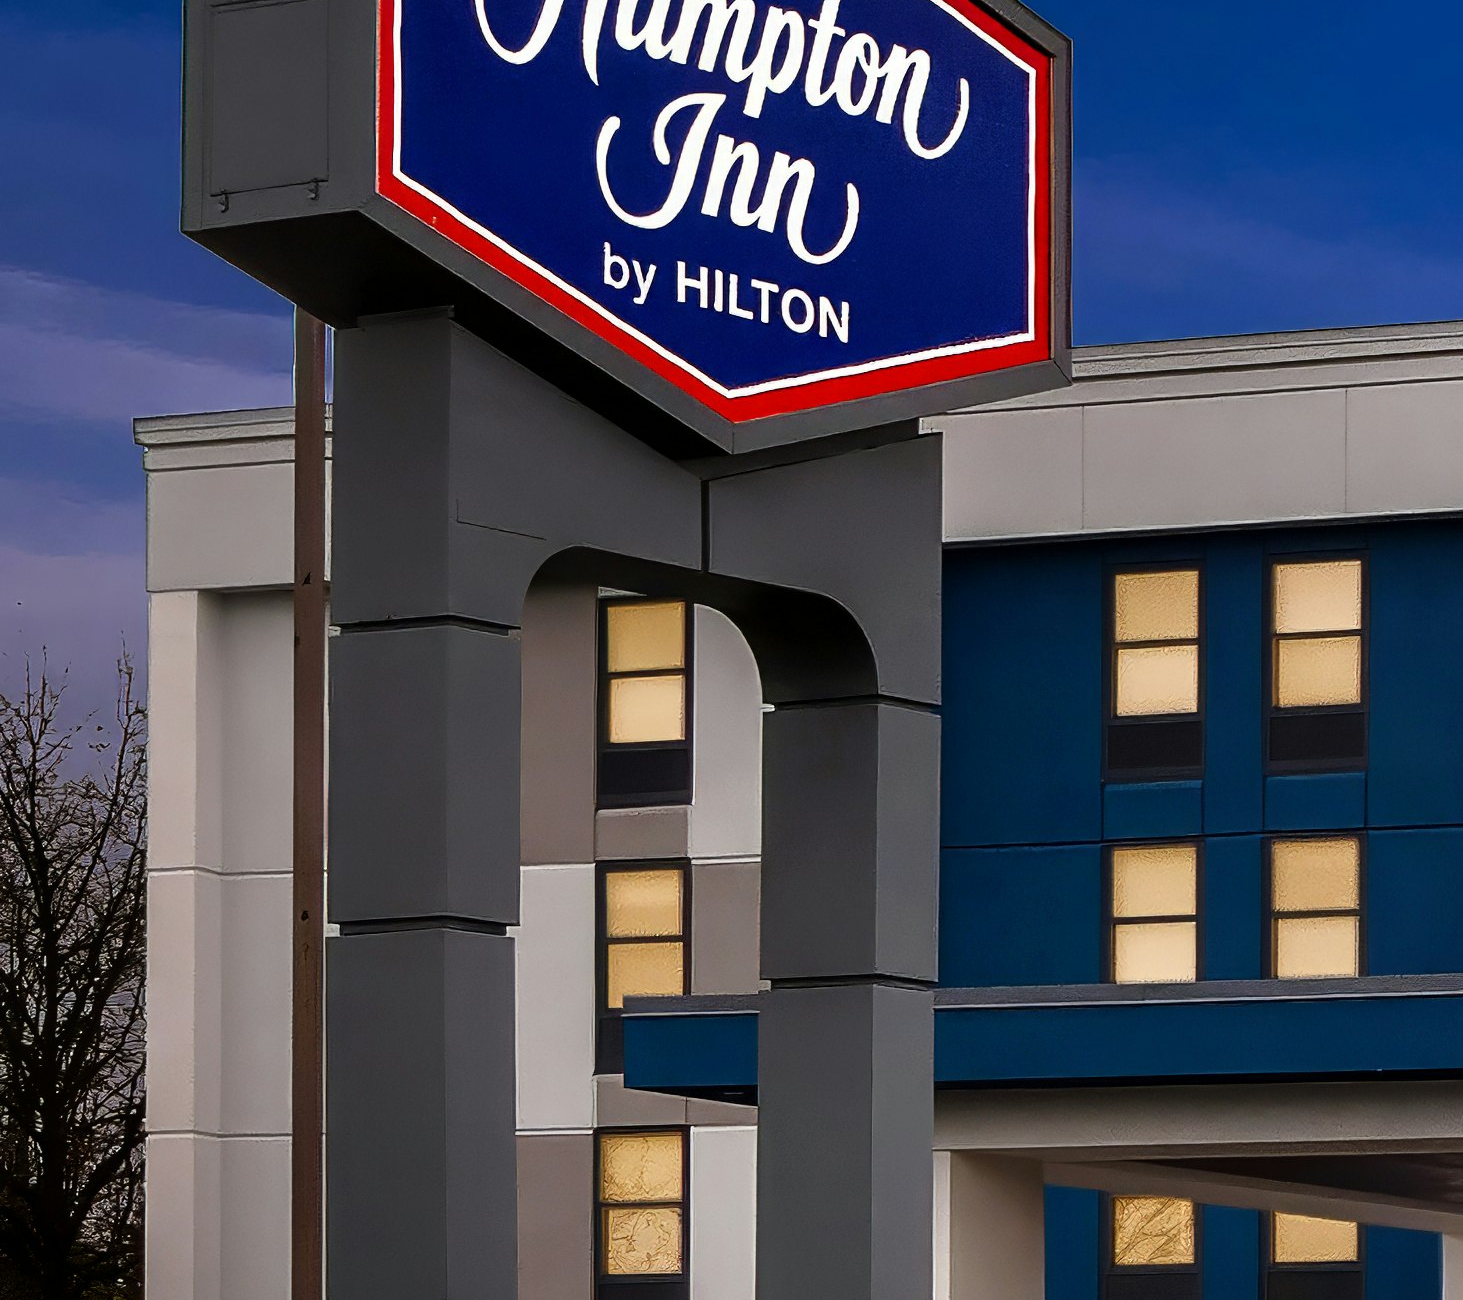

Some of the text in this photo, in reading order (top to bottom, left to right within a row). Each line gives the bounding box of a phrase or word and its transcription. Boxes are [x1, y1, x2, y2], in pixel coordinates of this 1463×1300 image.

[596, 93, 859, 264] Inn
[604, 242, 849, 343] by HILTON
